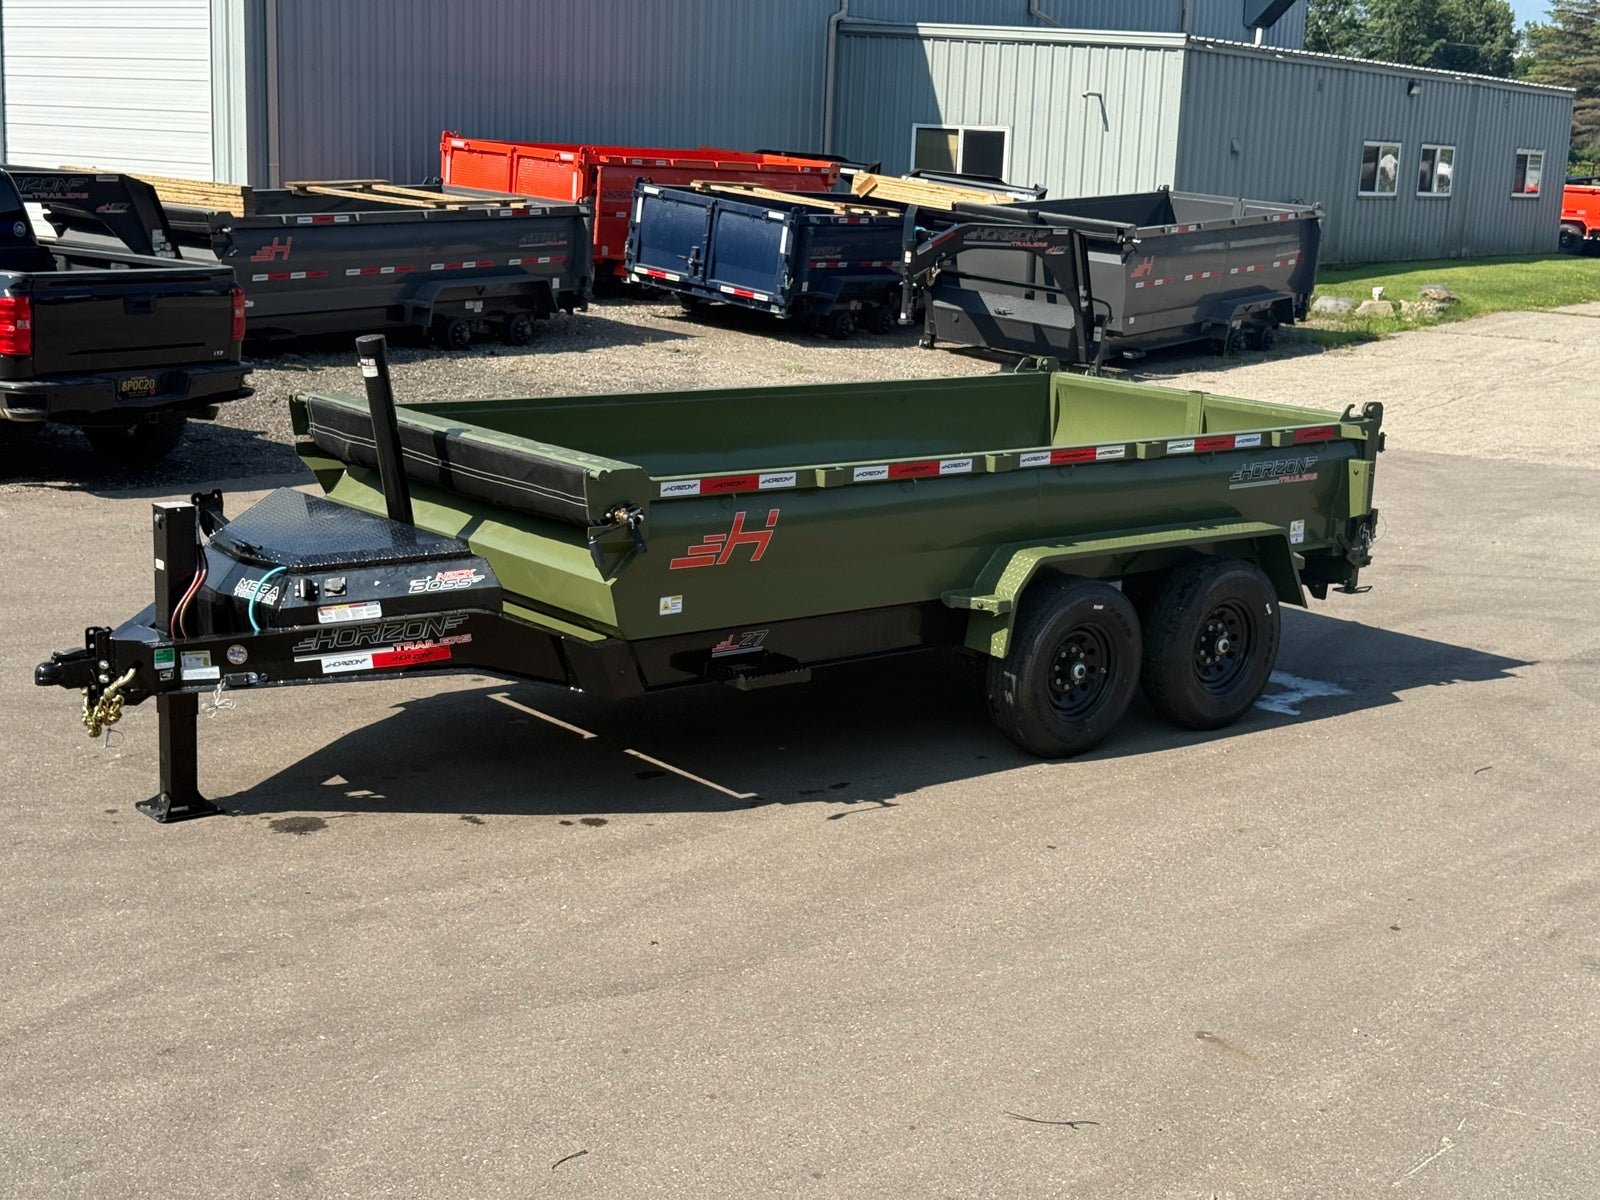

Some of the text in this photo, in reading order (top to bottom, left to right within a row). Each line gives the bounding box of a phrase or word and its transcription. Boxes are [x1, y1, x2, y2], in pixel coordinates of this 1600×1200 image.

[32, 192, 89, 200] TRAILERS
[1239, 457, 1308, 480] HORIZON
[1279, 472, 1319, 484] TRAILERS
[435, 568, 477, 580] NECK
[235, 577, 280, 600] MEGA
[408, 576, 474, 594] BOSS
[312, 615, 453, 650] HORIZON
[392, 633, 473, 652] TRAILERS
[323, 657, 369, 669] HORIZON
